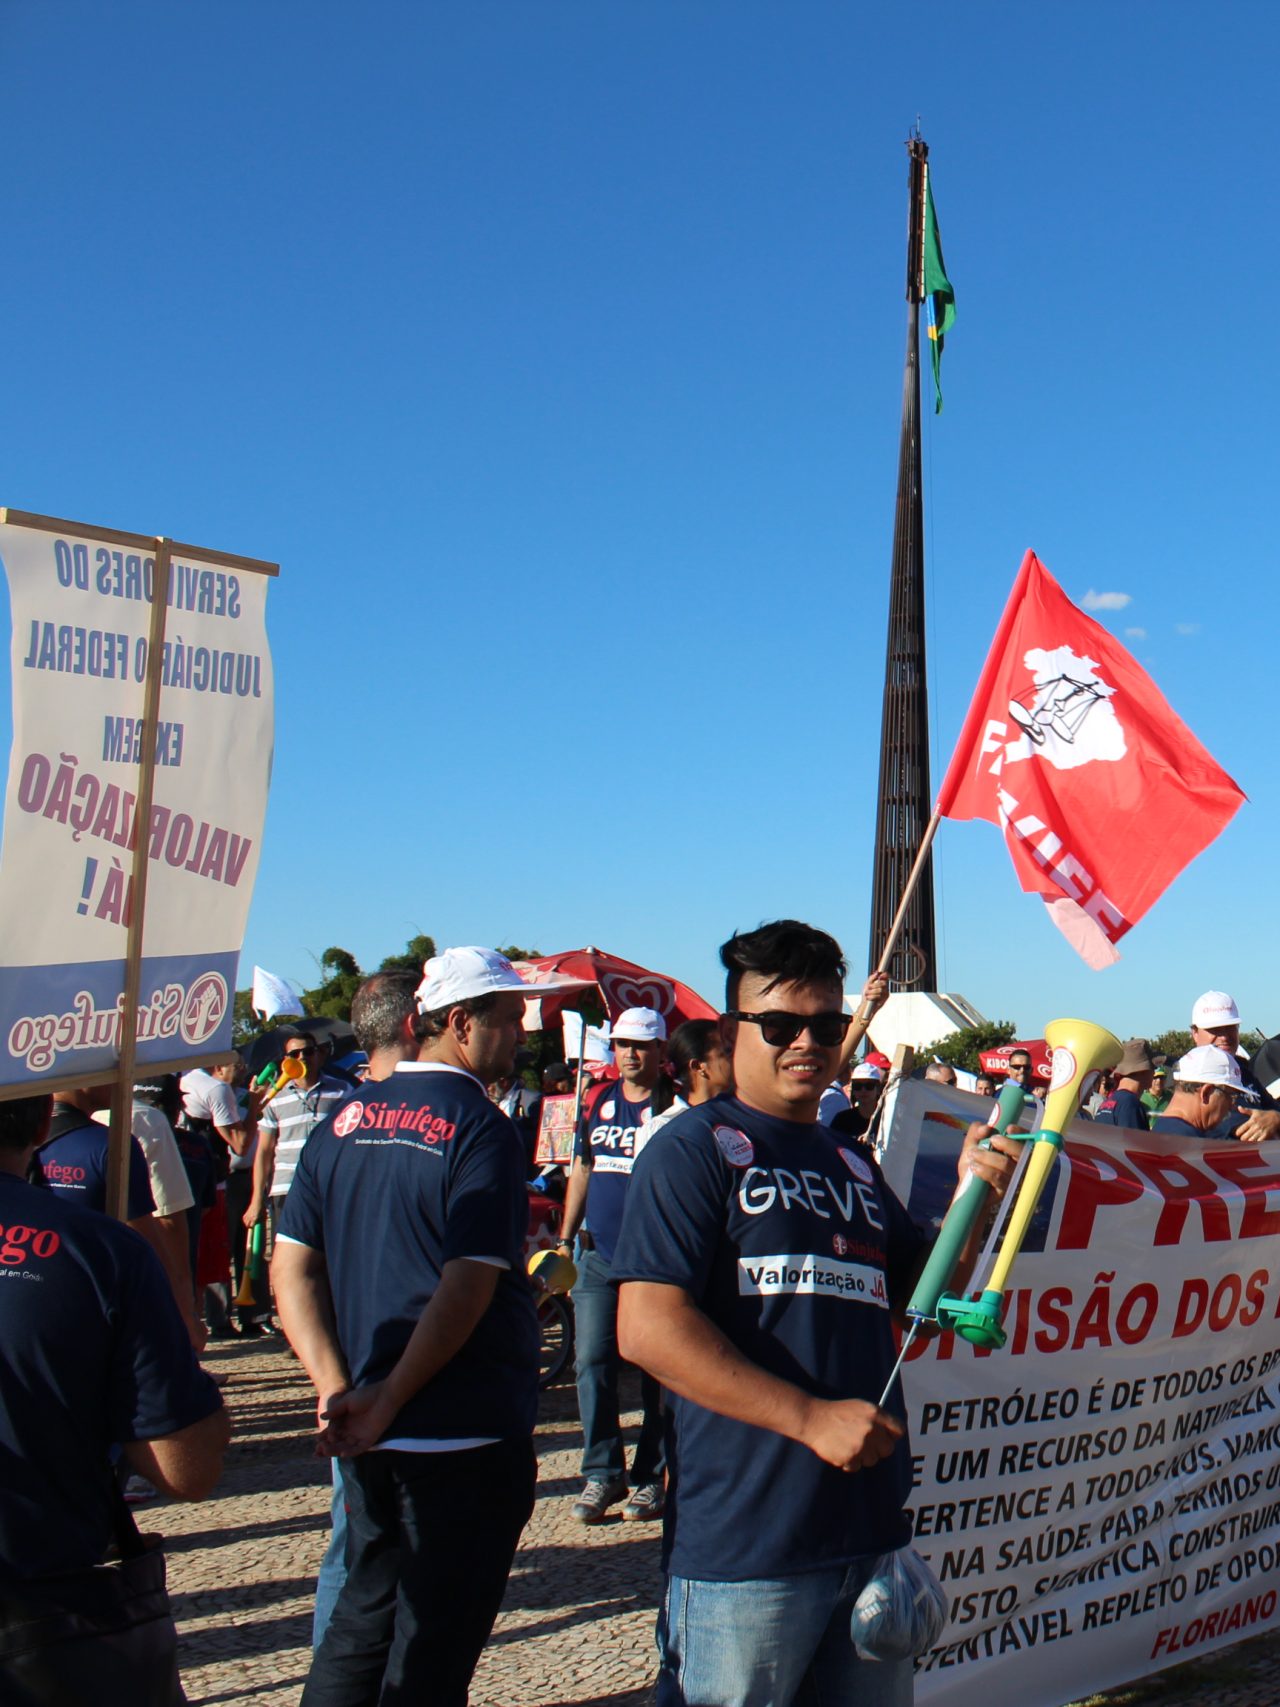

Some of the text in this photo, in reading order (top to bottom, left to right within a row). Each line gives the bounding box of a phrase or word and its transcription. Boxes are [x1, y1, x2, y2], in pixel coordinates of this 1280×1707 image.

[360, 1102, 457, 1144] Sinjufego
[739, 1166, 884, 1231] GREVE
[747, 1265, 865, 1293] Valorização
[900, 1270, 1159, 1362] VISÃO
[1171, 1268, 1269, 1338] DOS
[920, 1387, 1079, 1435] PETRÓLEO
[1087, 1377, 1105, 1415] É
[1111, 1378, 1146, 1411] DE
[1152, 1363, 1226, 1404] TODOS
[1229, 1355, 1257, 1386] OS
[935, 1448, 990, 1484] UM
[998, 1427, 1128, 1476] RECURSO
[1133, 1419, 1165, 1451] DA
[1172, 1384, 1276, 1442] NATUREZA
[1056, 1482, 1075, 1512] A
[1085, 1458, 1165, 1506] TODOS
[940, 1546, 985, 1582] NA
[995, 1523, 1091, 1571] SAÚDE.
[1101, 1500, 1164, 1544] PARA
[1168, 1470, 1263, 1518] TERMOS
[1034, 1540, 1160, 1595] SIGNIFICA
[1082, 1574, 1187, 1632] REPLETO
[1194, 1562, 1223, 1596] DE
[1151, 1590, 1277, 1660] FLORIANO
